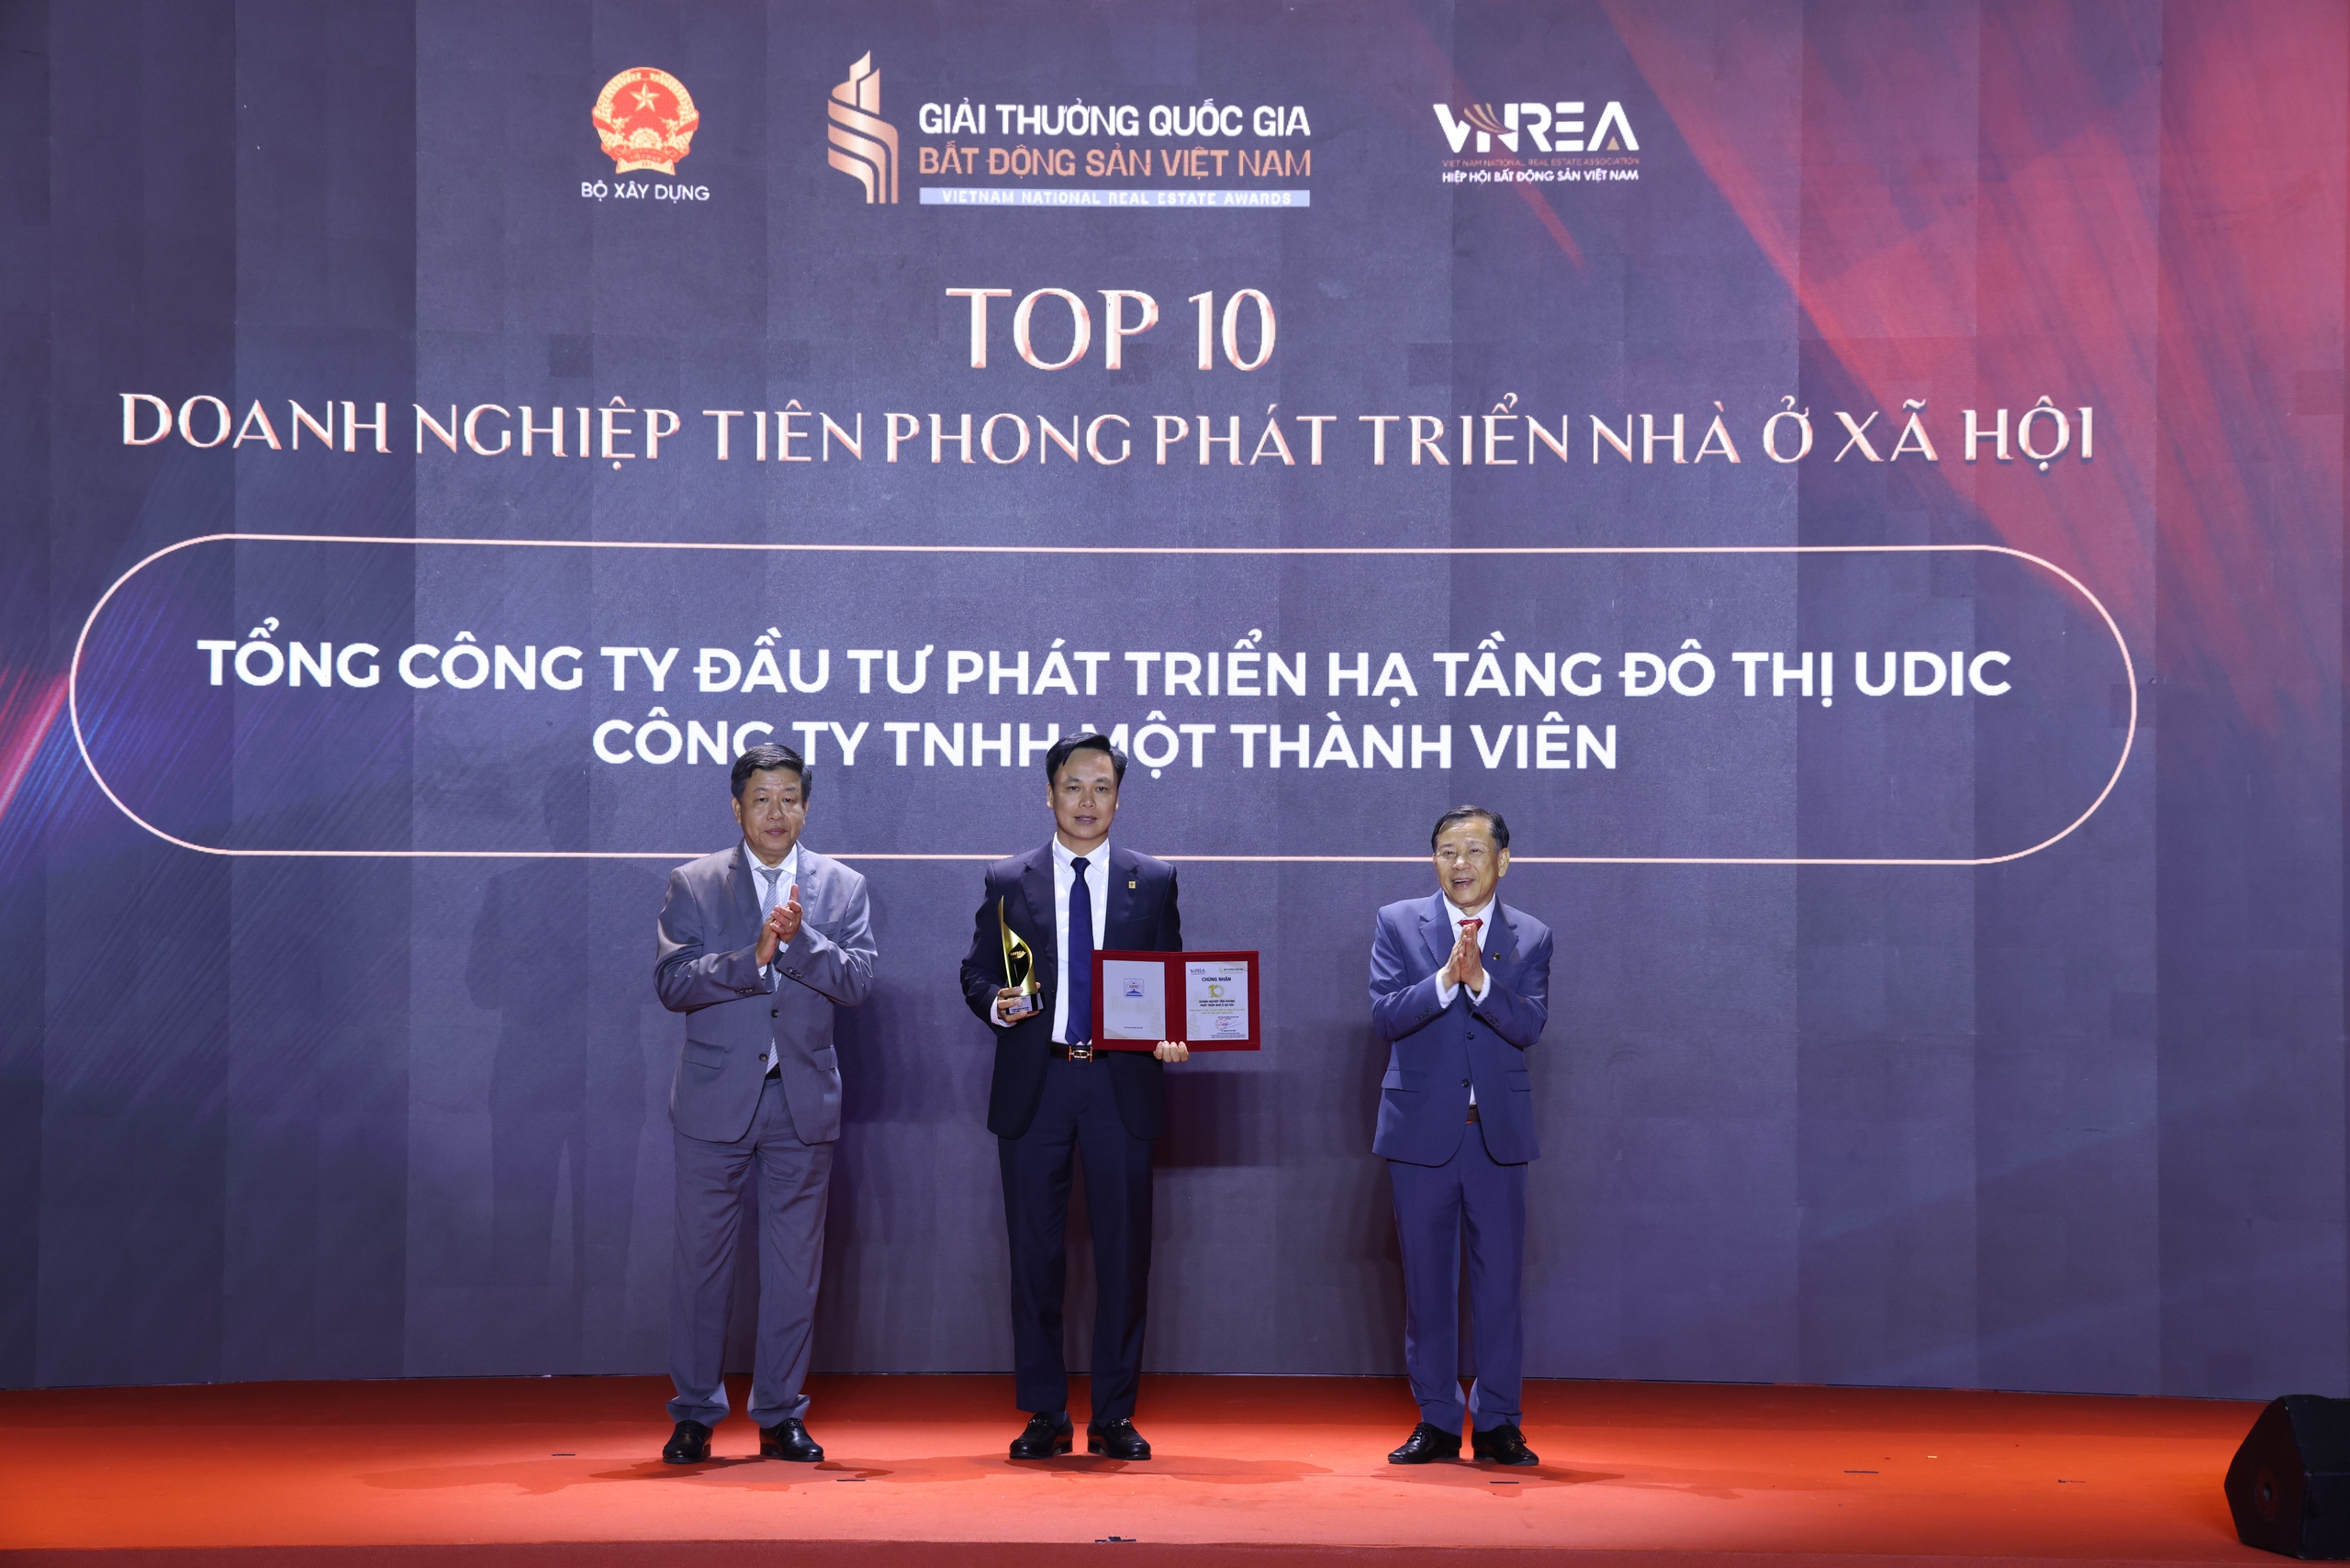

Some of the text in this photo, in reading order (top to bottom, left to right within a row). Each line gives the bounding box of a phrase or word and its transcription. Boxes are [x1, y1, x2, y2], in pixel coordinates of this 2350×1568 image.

[919, 96, 1311, 137] GIẢI THƯỞNG QUỐC GIA
[1433, 101, 1639, 153] VNREA
[919, 140, 1311, 181] BẤT ĐỘNG SẢN VIỆT NAM
[1441, 167, 1639, 186] HIỆP HỘI BẤT ĐỘNG SẢN VIỆT NAM
[1461, 158, 1482, 168] NAM
[1528, 158, 1550, 167] REAL
[1550, 158, 1582, 167] ESTATE
[1583, 157, 1640, 166] ASSOCIATION
[581, 179, 711, 204] BỘ XÂY DỰNG
[942, 189, 1292, 206] VIETNAM NATIONAL REAL ESTATE AWARDS
[945, 287, 1276, 371] TOP 10
[119, 392, 2093, 471] DOANH NGHIỆP TIÊN PHONG PHÁT TRIỂN NHÀ Ở XÃ HỘI
[196, 616, 2012, 708] TỔNG CÔNG TY ĐẦU TƯ PHÁT TRIỂN HẠ TẦNG ĐÔ THỊ UDIC
[791, 721, 869, 767] TY
[883, 722, 1059, 767] TNHH
[1229, 711, 1452, 769] THÀNH
[1469, 711, 1617, 769] VIÊN
